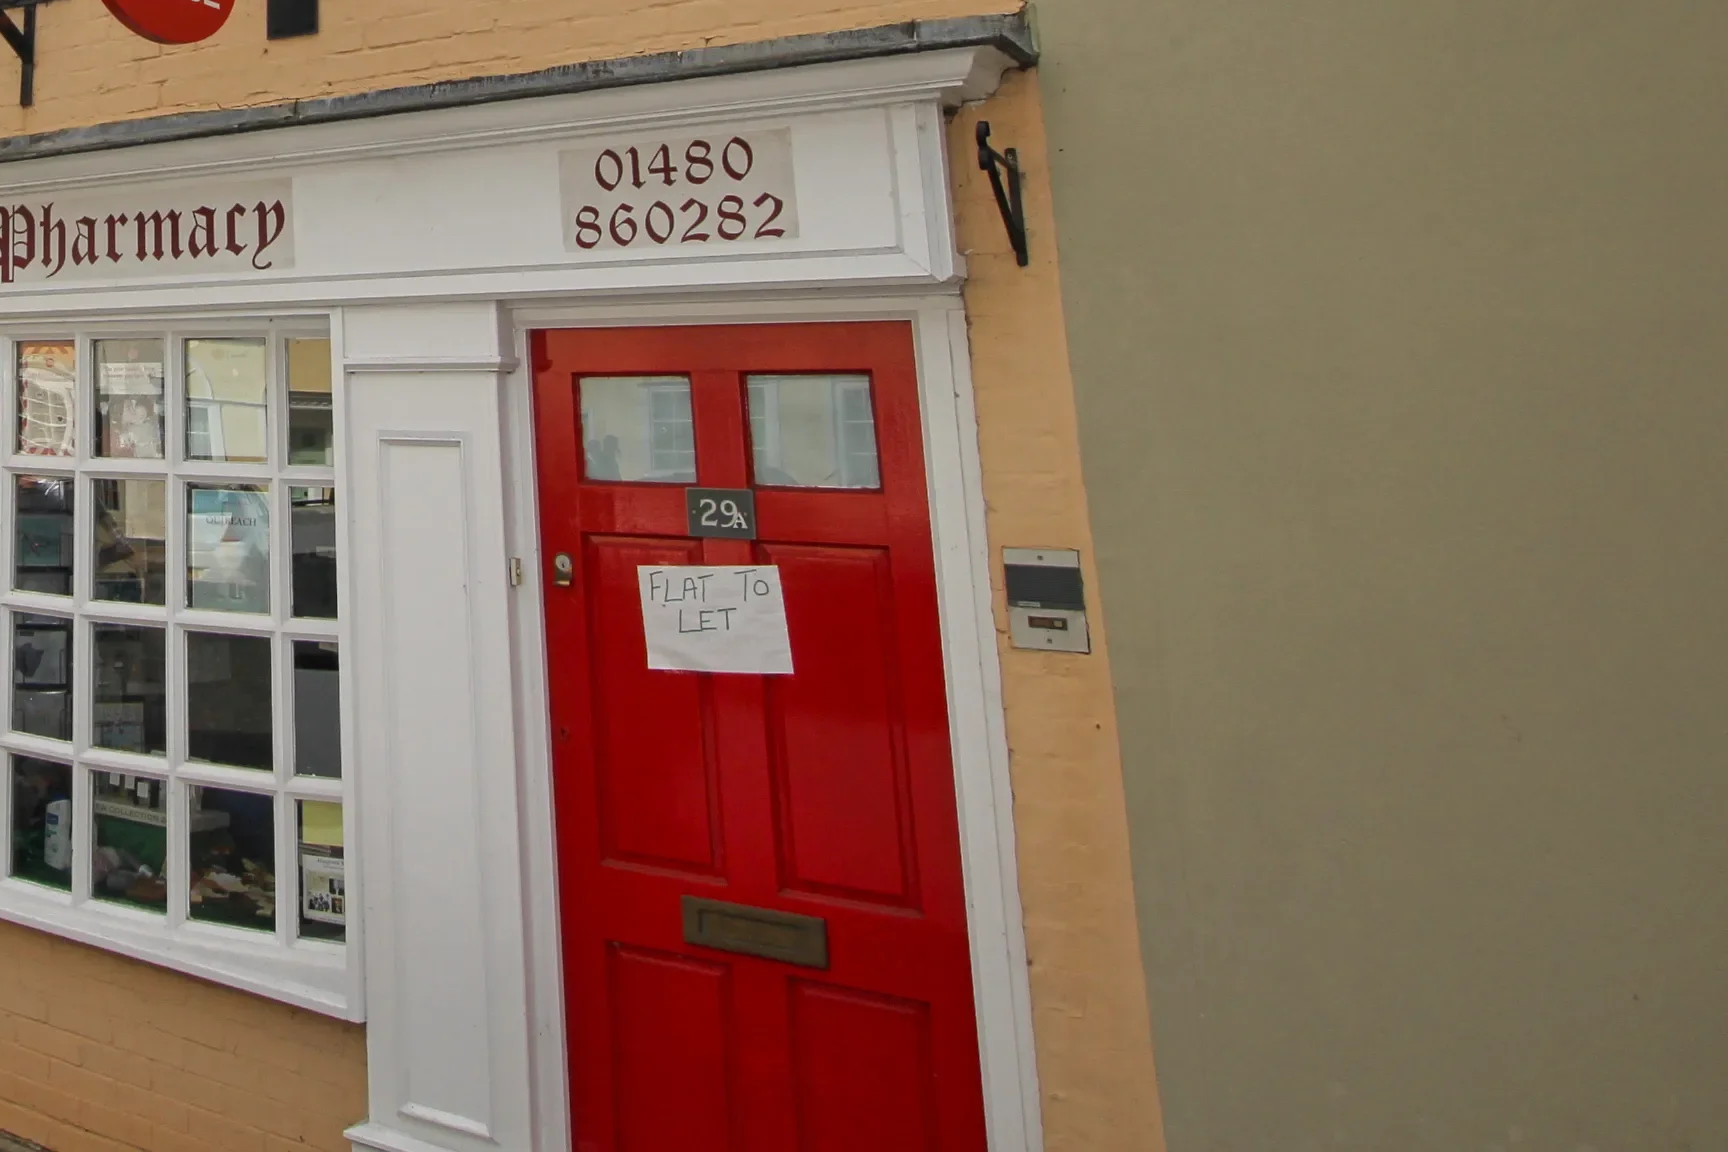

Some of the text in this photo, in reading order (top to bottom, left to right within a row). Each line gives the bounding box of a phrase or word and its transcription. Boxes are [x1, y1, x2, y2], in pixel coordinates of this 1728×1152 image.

[594, 135, 754, 192] 01480
[575, 192, 786, 250] 860282
[699, 498, 749, 530] 29A
[649, 568, 770, 603] FLAT TO
[678, 607, 738, 634] LET
